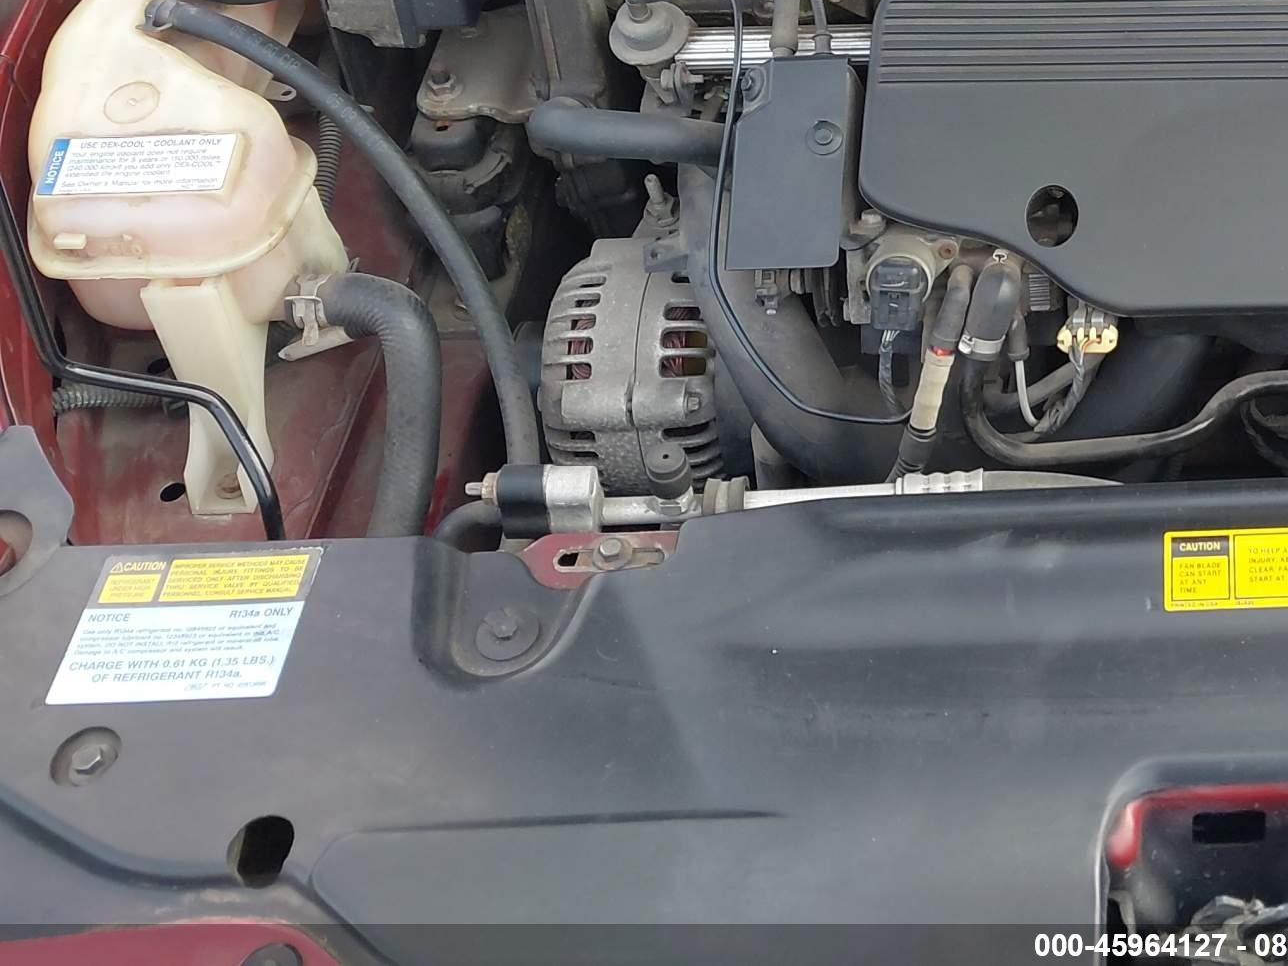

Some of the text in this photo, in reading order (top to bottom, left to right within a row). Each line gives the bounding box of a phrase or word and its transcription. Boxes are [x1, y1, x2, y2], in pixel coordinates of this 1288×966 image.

[152, 138, 196, 146] COOLANT
[44, 148, 65, 184] NOTICE
[1179, 542, 1221, 552] CAUTION
[124, 560, 166, 571] CAUTION
[87, 606, 292, 623] NOTICE R134a ONLY
[68, 655, 275, 671] CHARGE WITH 0.61 KG (1.35 LBS.)
[90, 673, 110, 682] OF
[112, 670, 201, 682] REFRIGERANT
